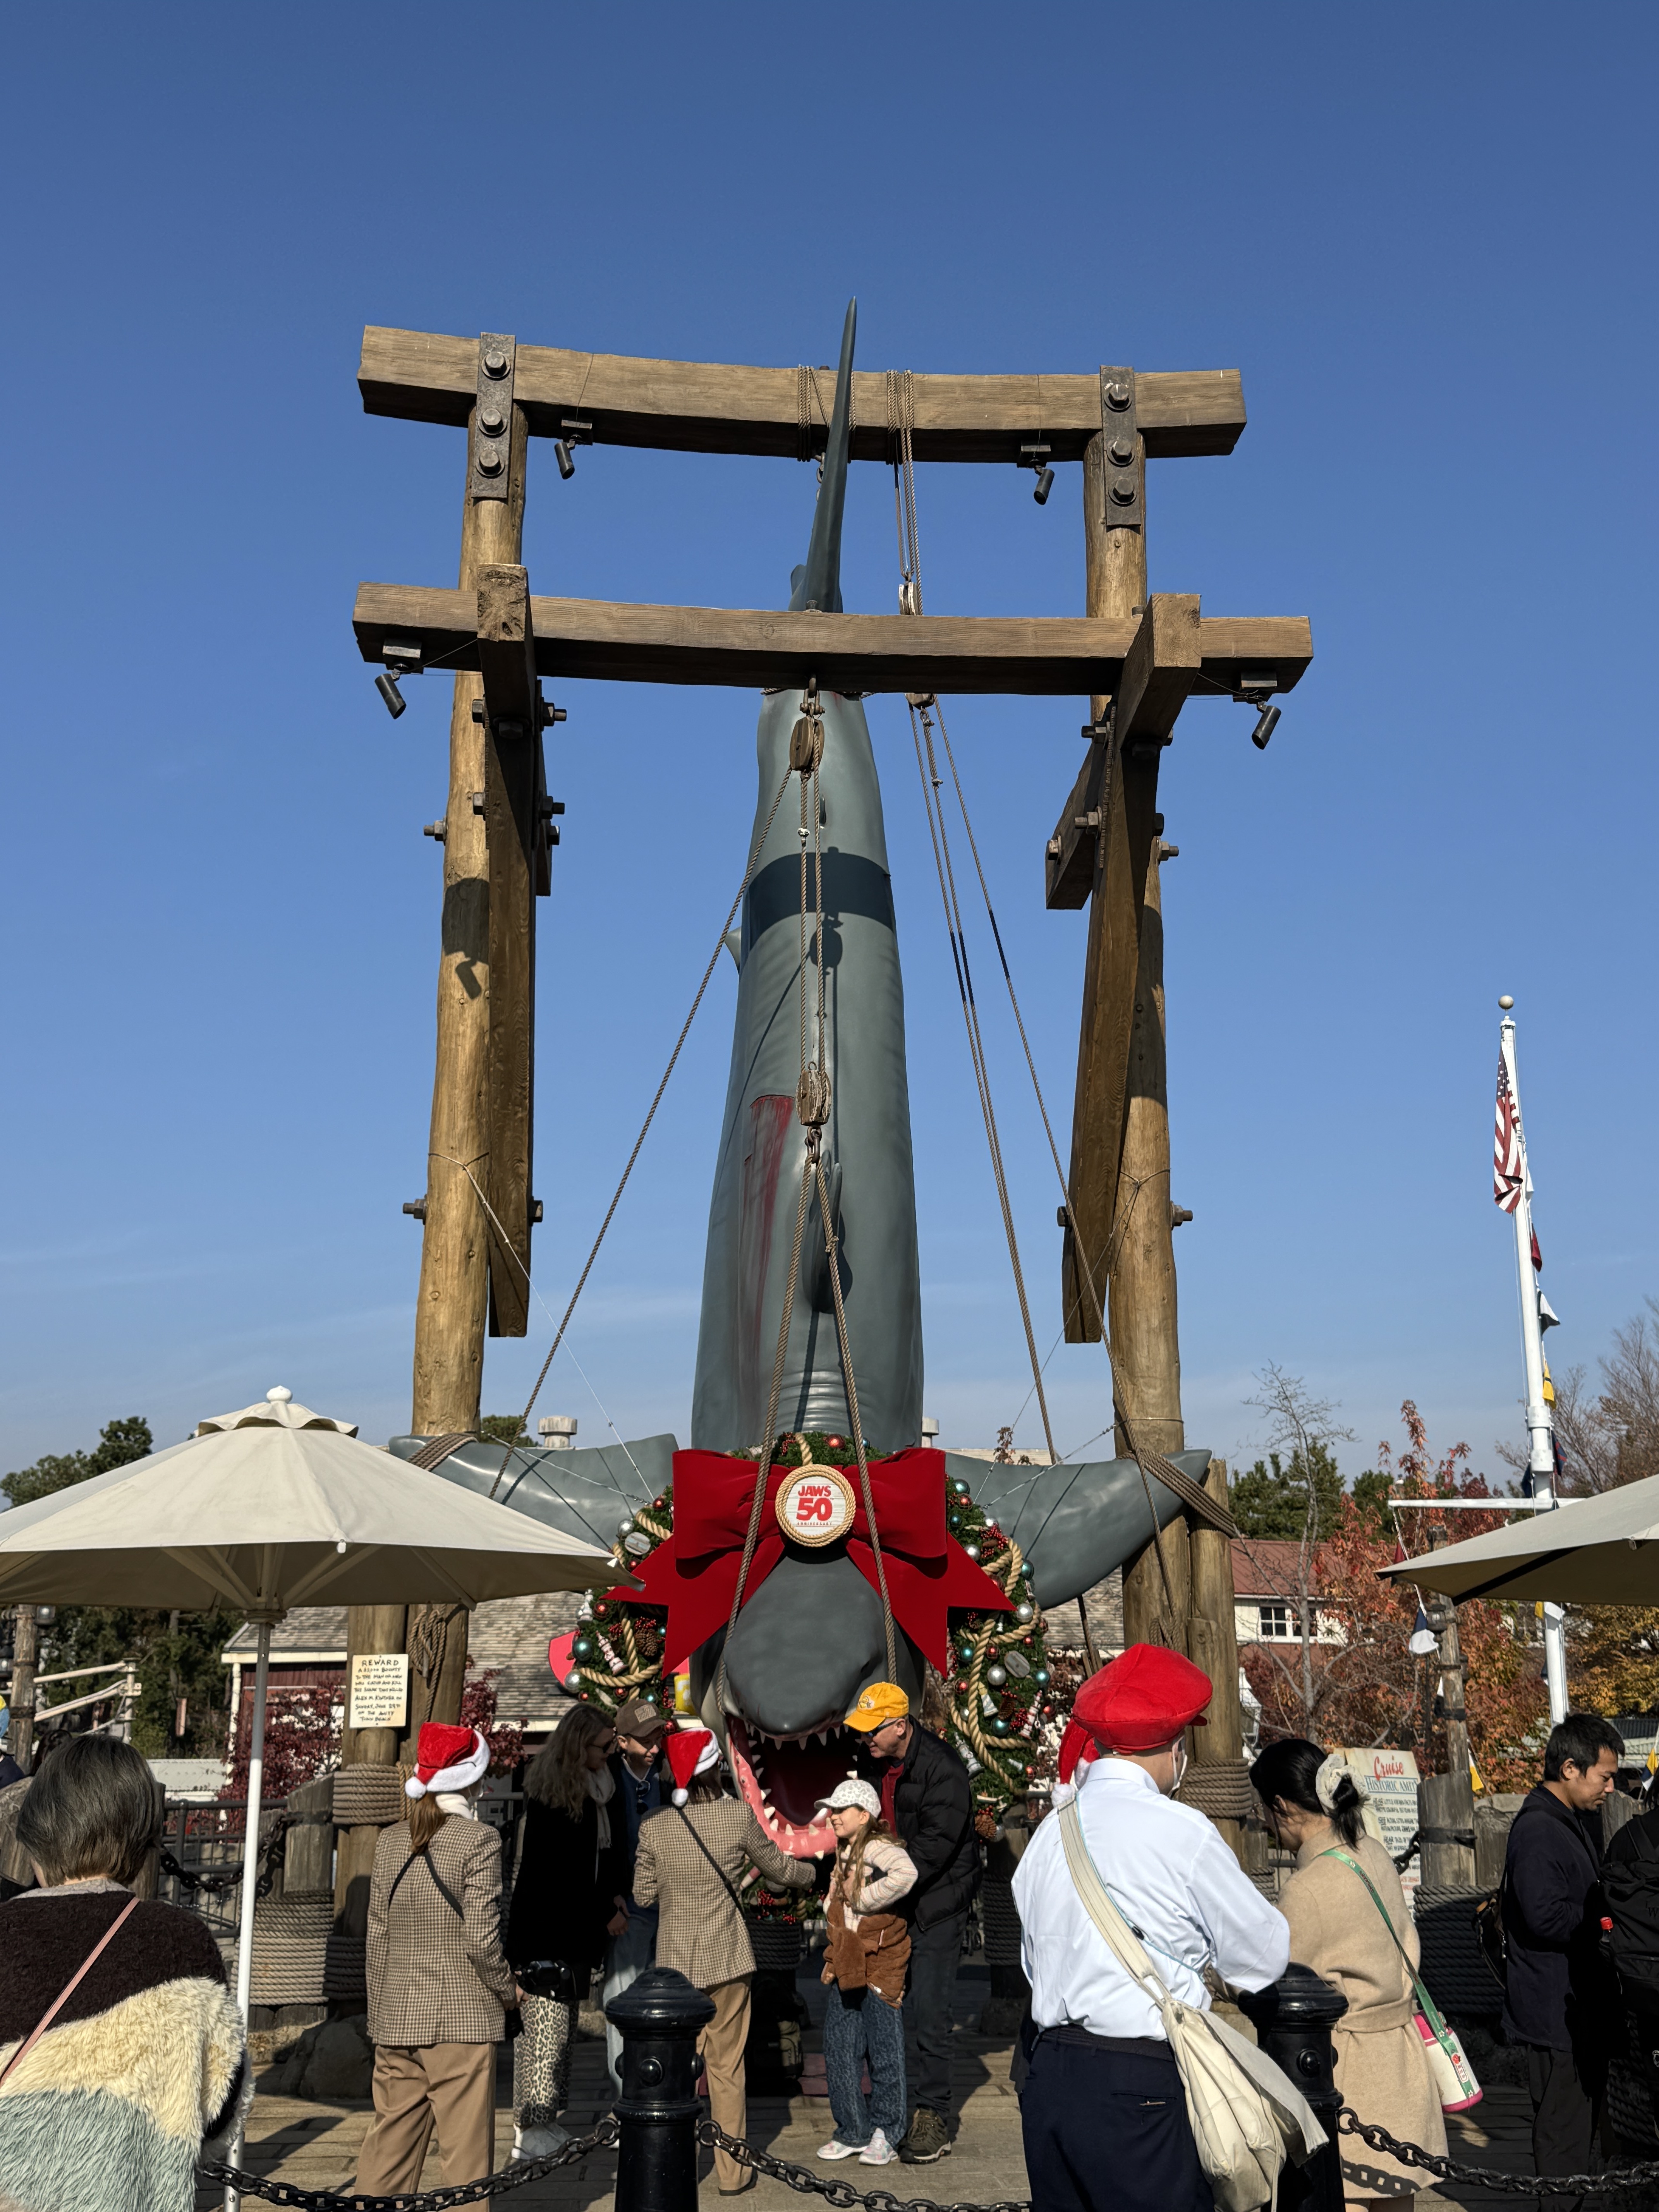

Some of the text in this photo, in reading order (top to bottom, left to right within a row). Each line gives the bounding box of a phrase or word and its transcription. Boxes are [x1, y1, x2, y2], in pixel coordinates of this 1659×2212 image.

[798, 1486, 831, 1497] JAWS
[796, 1498, 833, 1521] 50
[1374, 1755, 1403, 1781] Cruise
[1365, 1777, 1398, 1791] HISTORIC
